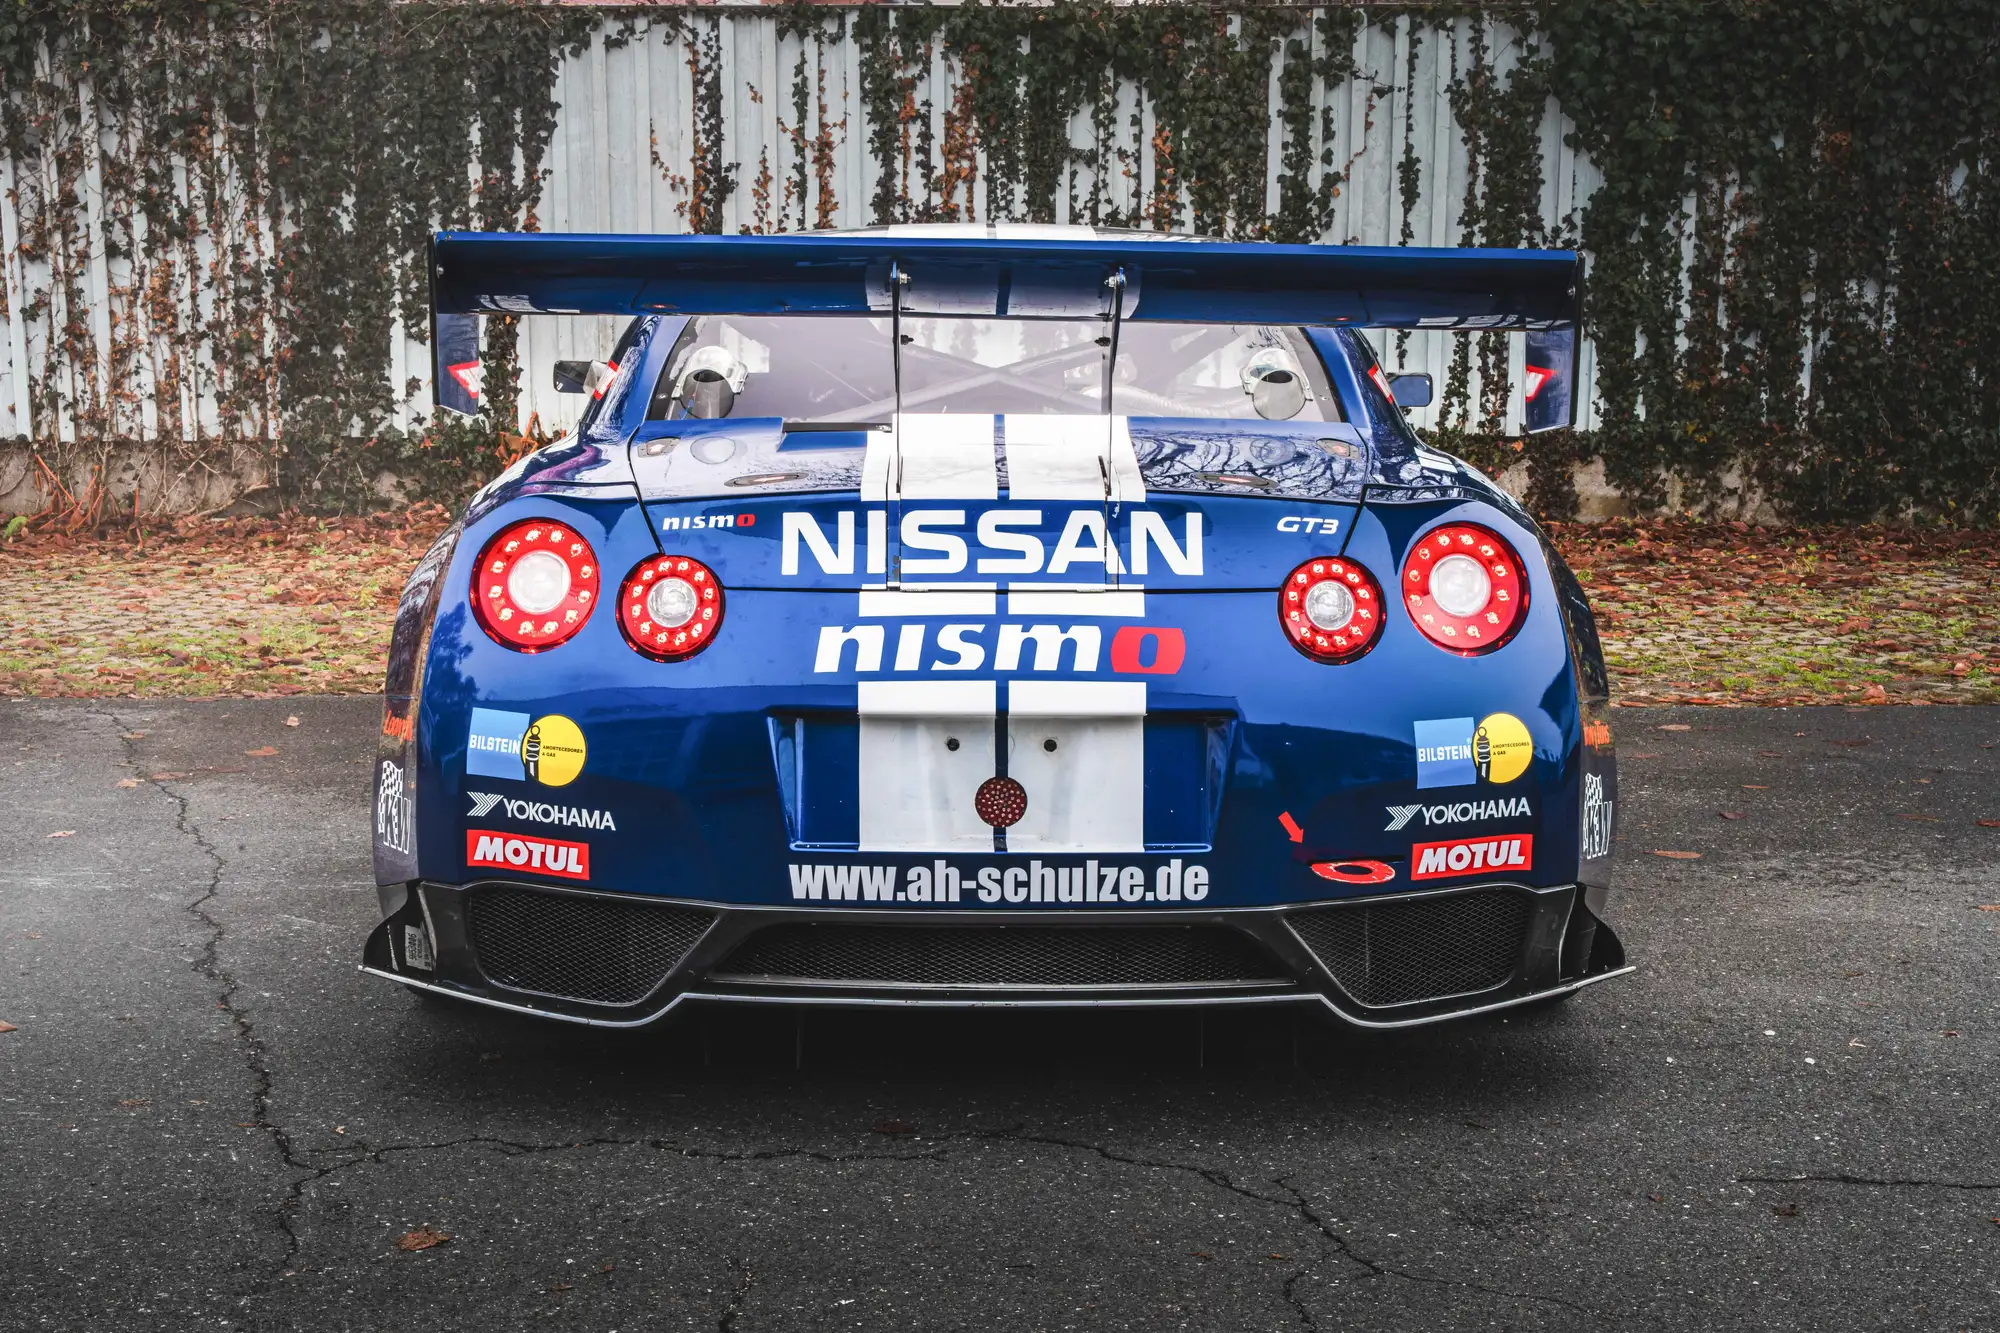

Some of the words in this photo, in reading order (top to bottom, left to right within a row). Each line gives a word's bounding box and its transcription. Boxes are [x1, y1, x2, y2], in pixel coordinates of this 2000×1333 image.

[662, 513, 756, 531] nismo
[1276, 516, 1339, 535] GT3
[781, 509, 1204, 576] NISSAN
[813, 623, 1187, 675] nismo
[469, 734, 521, 755] BILSTEIN
[1418, 744, 1472, 763] BILSTEIN
[503, 797, 616, 831] YOKOHAMA
[1422, 797, 1532, 826] YOKOHAMA
[473, 835, 583, 873] MOTUL
[1417, 840, 1526, 874] MOTUL
[789, 859, 1209, 902] www.ah-schulze.de
